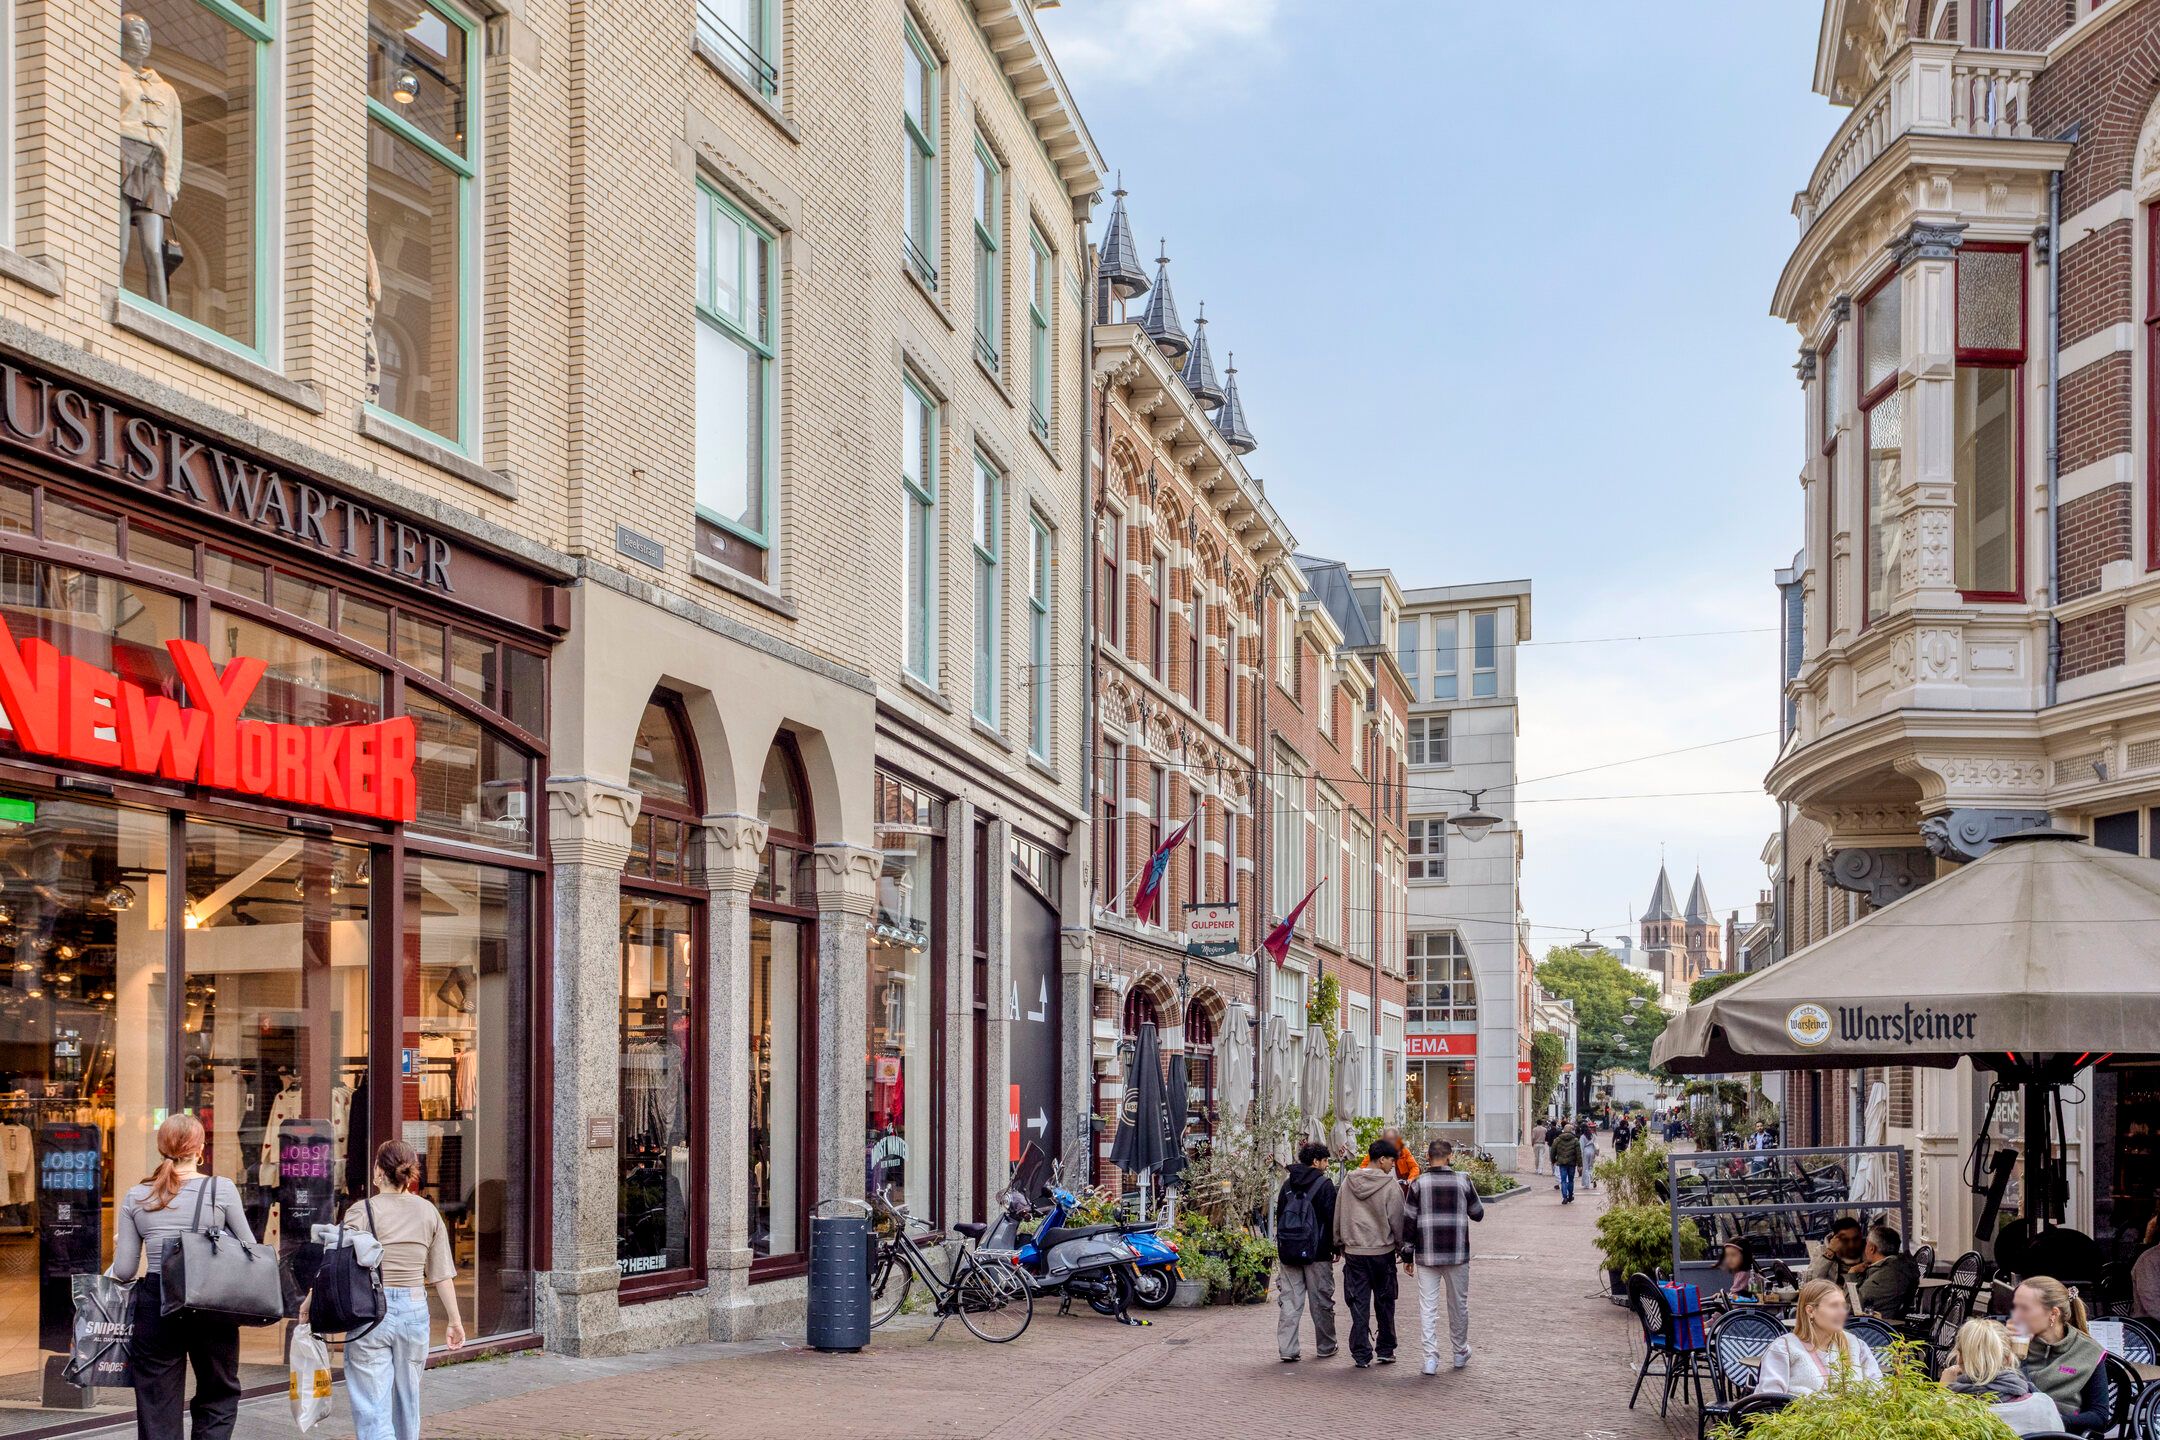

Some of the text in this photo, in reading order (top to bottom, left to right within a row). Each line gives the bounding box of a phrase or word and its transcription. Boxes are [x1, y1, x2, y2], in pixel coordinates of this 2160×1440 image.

[624, 534, 658, 560] Beekstraat
[1191, 920, 1235, 929] GULPENER
[1789, 1018, 1829, 1031] Warsteiner
[1838, 1001, 1978, 1046] Warsteiner
[42, 1151, 96, 1169] JOBS?
[281, 1144, 329, 1160] JOBS?
[281, 1162, 328, 1178] HERE!
[42, 1172, 94, 1190] HERE!
[629, 1255, 659, 1272] HERE!
[98, 1361, 124, 1373] snipes
